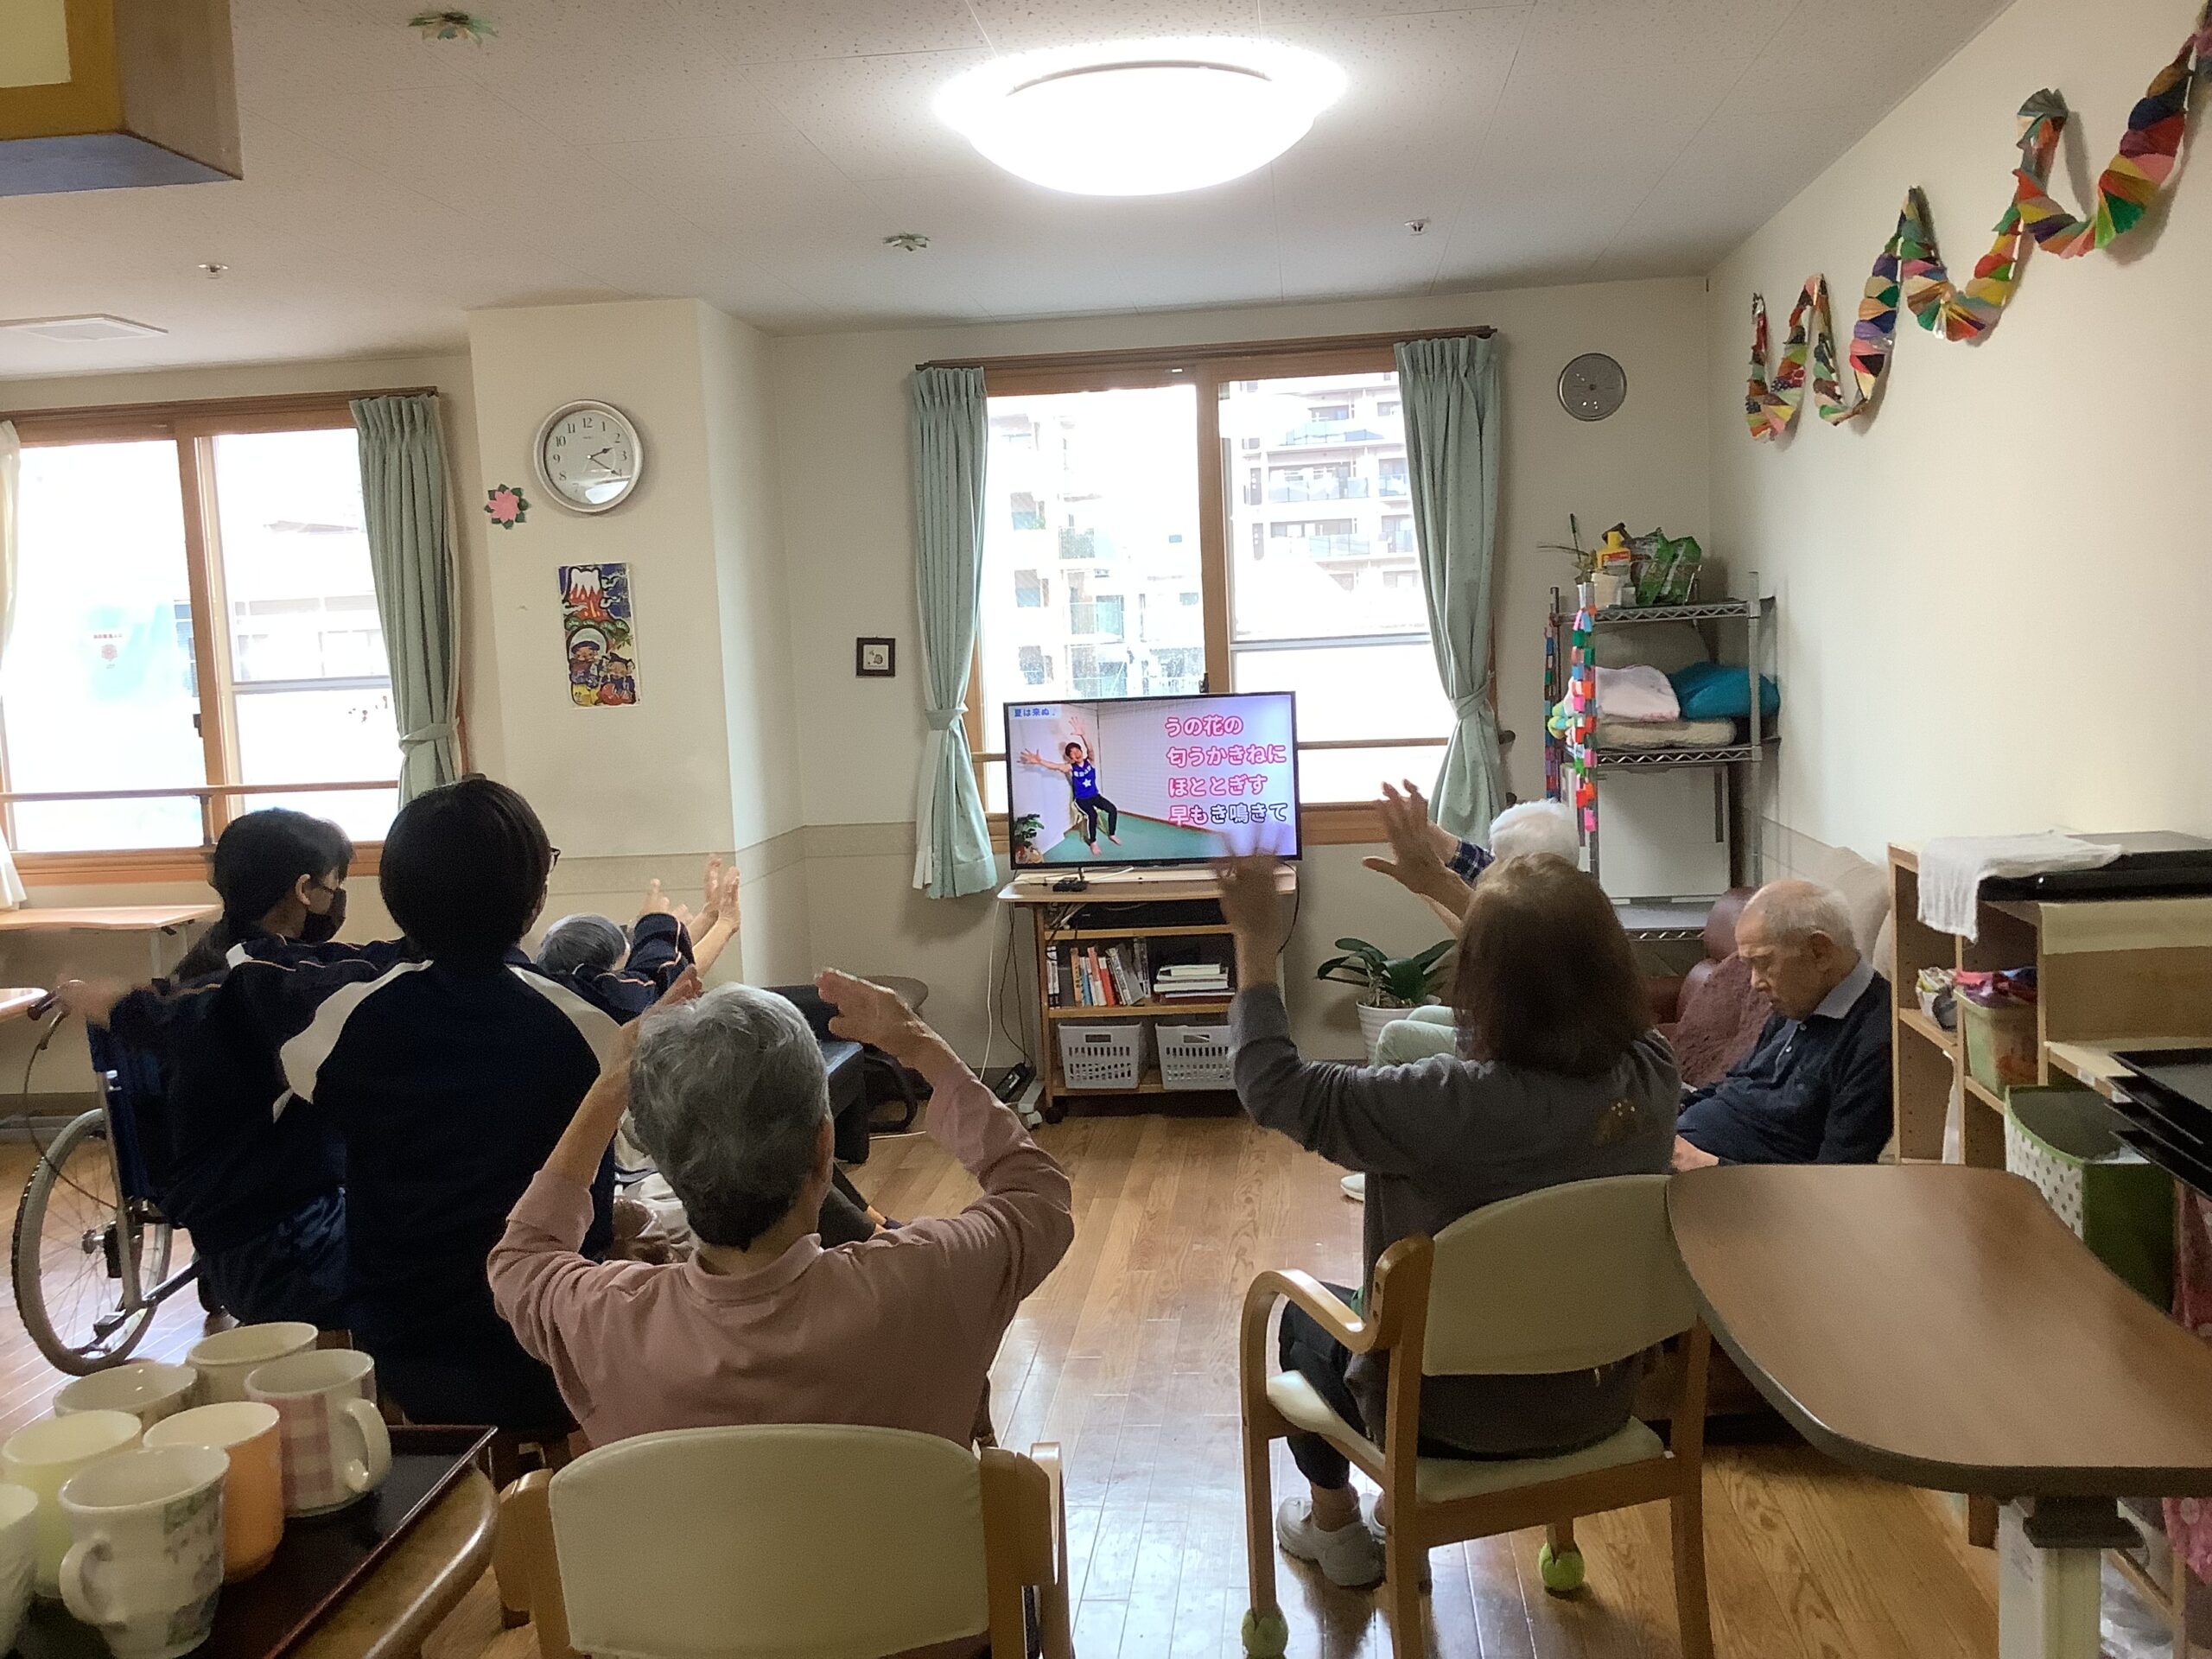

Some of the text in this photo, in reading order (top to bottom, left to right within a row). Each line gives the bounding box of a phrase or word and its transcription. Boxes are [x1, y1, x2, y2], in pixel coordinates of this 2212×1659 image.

[568, 423, 575, 434] 11
[582, 417, 593, 429] 12
[601, 421, 606, 432] 1
[556, 435, 566, 448] 10
[614, 433, 620, 443] 2
[553, 454, 561, 463] 9
[622, 450, 627, 461] 3
[1165, 715, 1243, 738] うの花の
[1166, 744, 1287, 768] 匂うかきねに
[1168, 773, 1268, 798] ほととぎす
[1169, 802, 1287, 827] 早もき鳴きて
